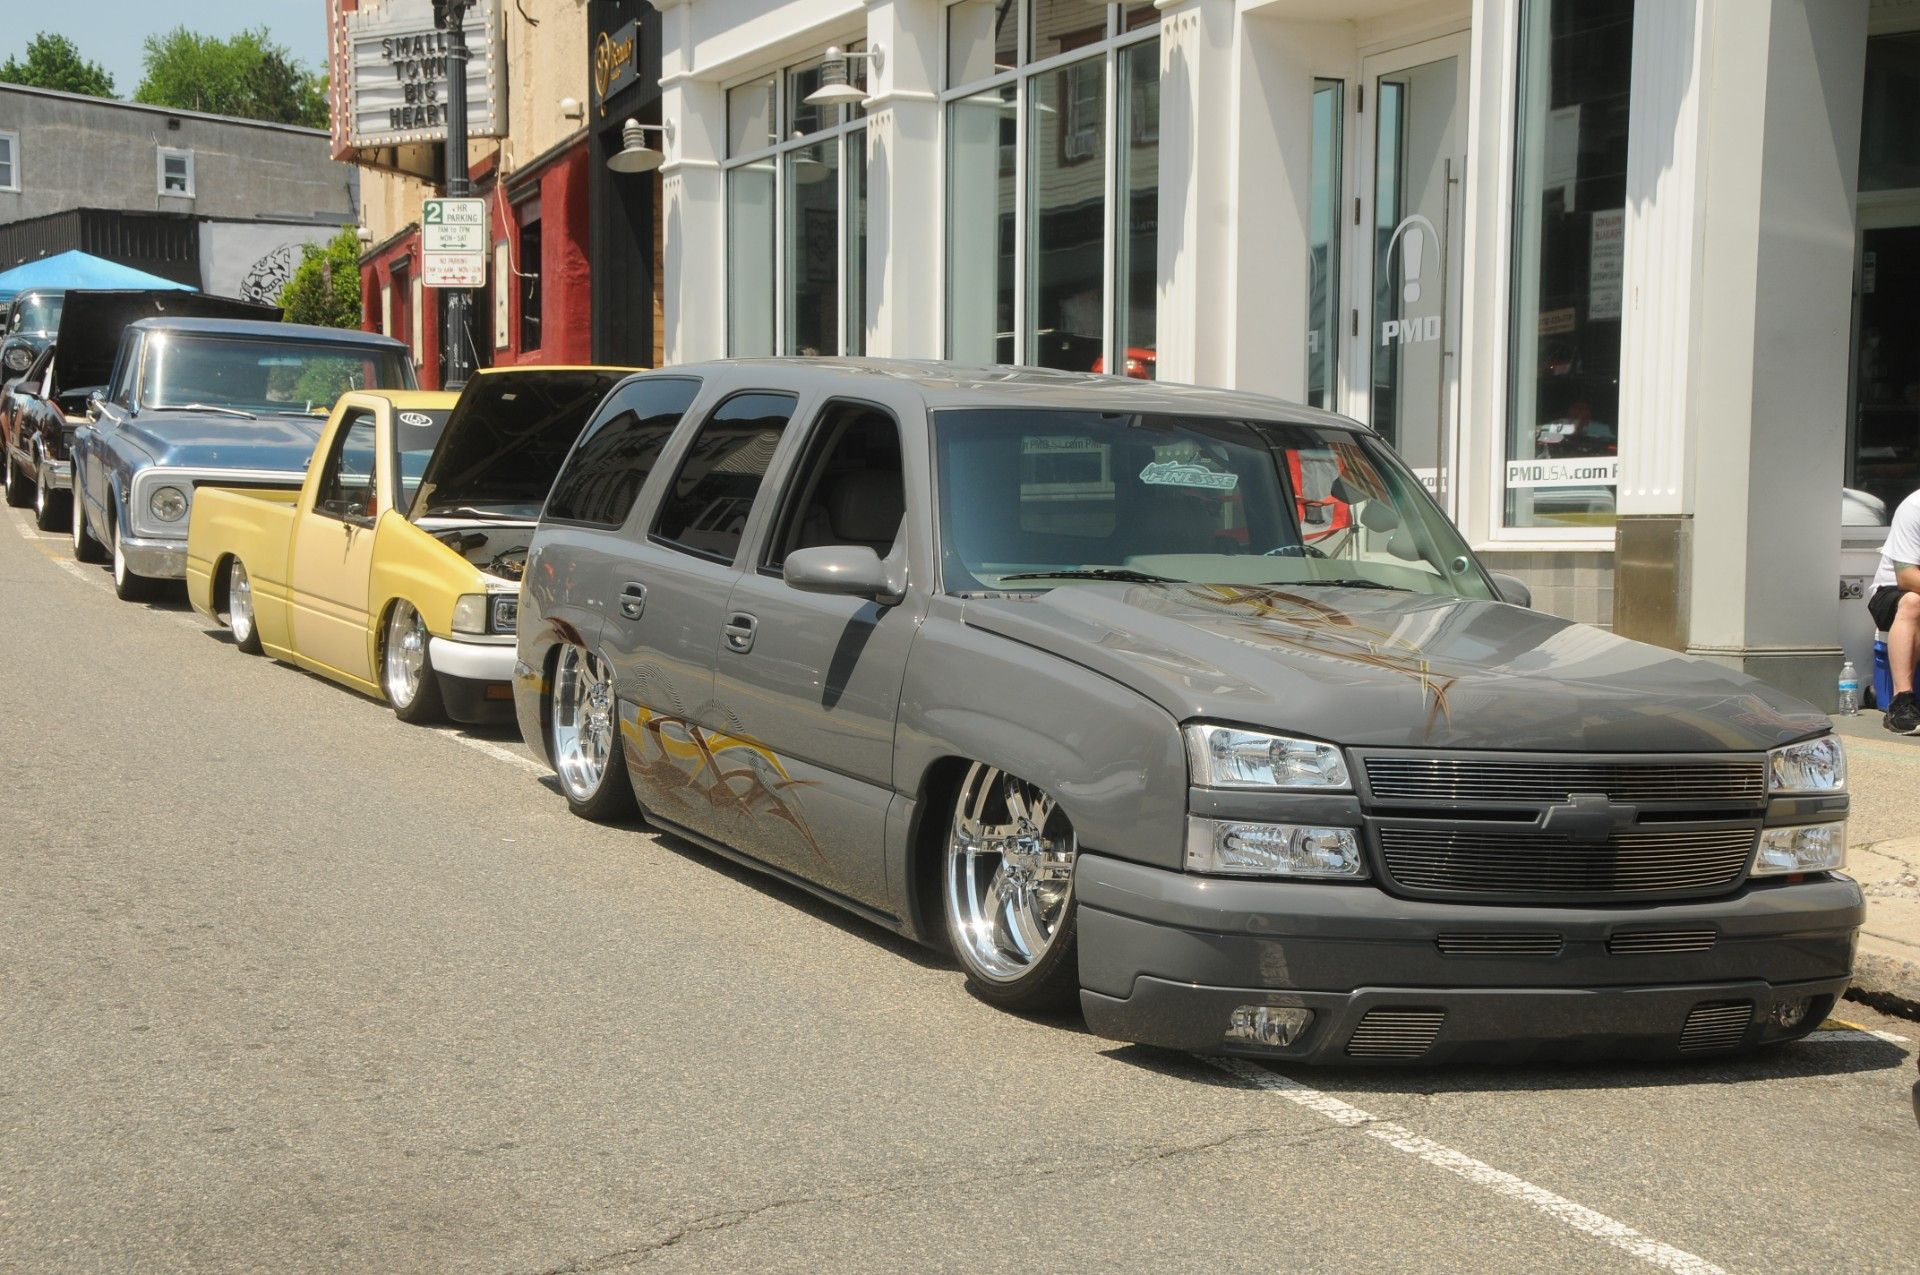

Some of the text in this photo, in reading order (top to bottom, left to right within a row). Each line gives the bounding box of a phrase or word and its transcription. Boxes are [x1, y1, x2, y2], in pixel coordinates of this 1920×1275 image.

[382, 32, 447, 58] SMALL
[393, 56, 448, 81] TOWN
[404, 81, 437, 104] BIG
[389, 102, 448, 131] HEART
[427, 202, 468, 223] 2 HR
[446, 214, 478, 223] PARKING
[1382, 316, 1440, 346] PMD
[1509, 464, 1608, 481] PMDUSA.com
